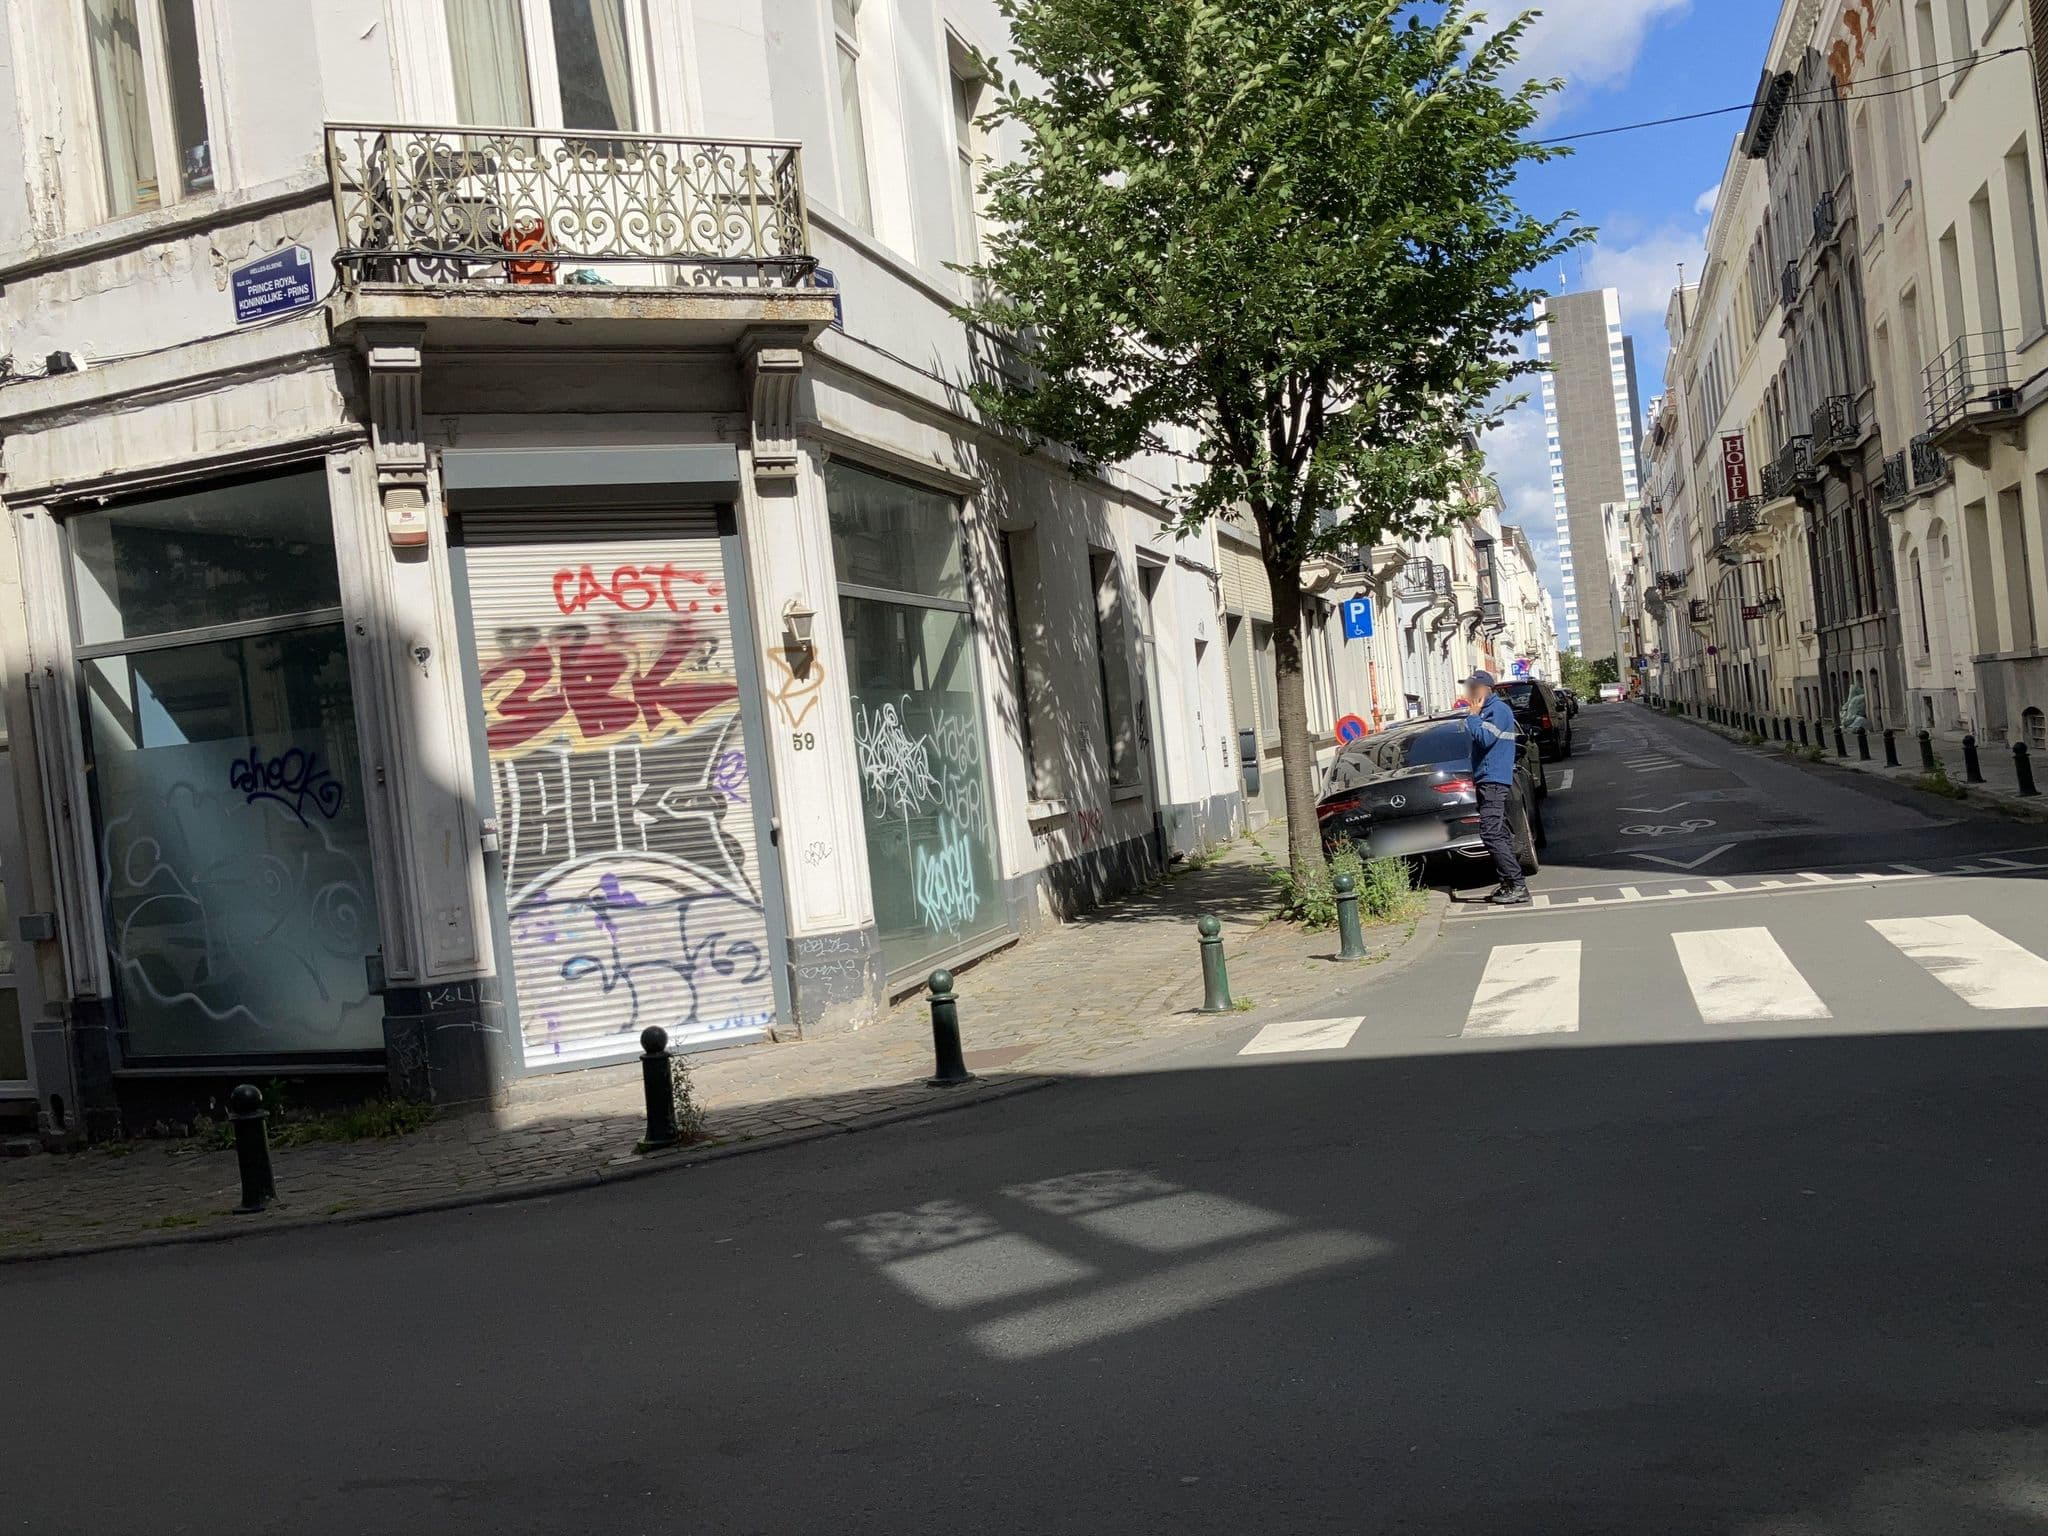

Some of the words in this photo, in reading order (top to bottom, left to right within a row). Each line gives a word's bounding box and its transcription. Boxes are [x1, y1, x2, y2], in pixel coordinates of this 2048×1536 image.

[247, 281, 274, 296] PRINCE
[274, 275, 297, 289] ROYAL
[239, 290, 284, 310] KONINKLIJKE
[287, 284, 309, 298] PRINS
[1725, 440, 1745, 500] HOTEL
[1350, 602, 1365, 623] P
[1512, 664, 1519, 674] P
[792, 733, 815, 751] 59
